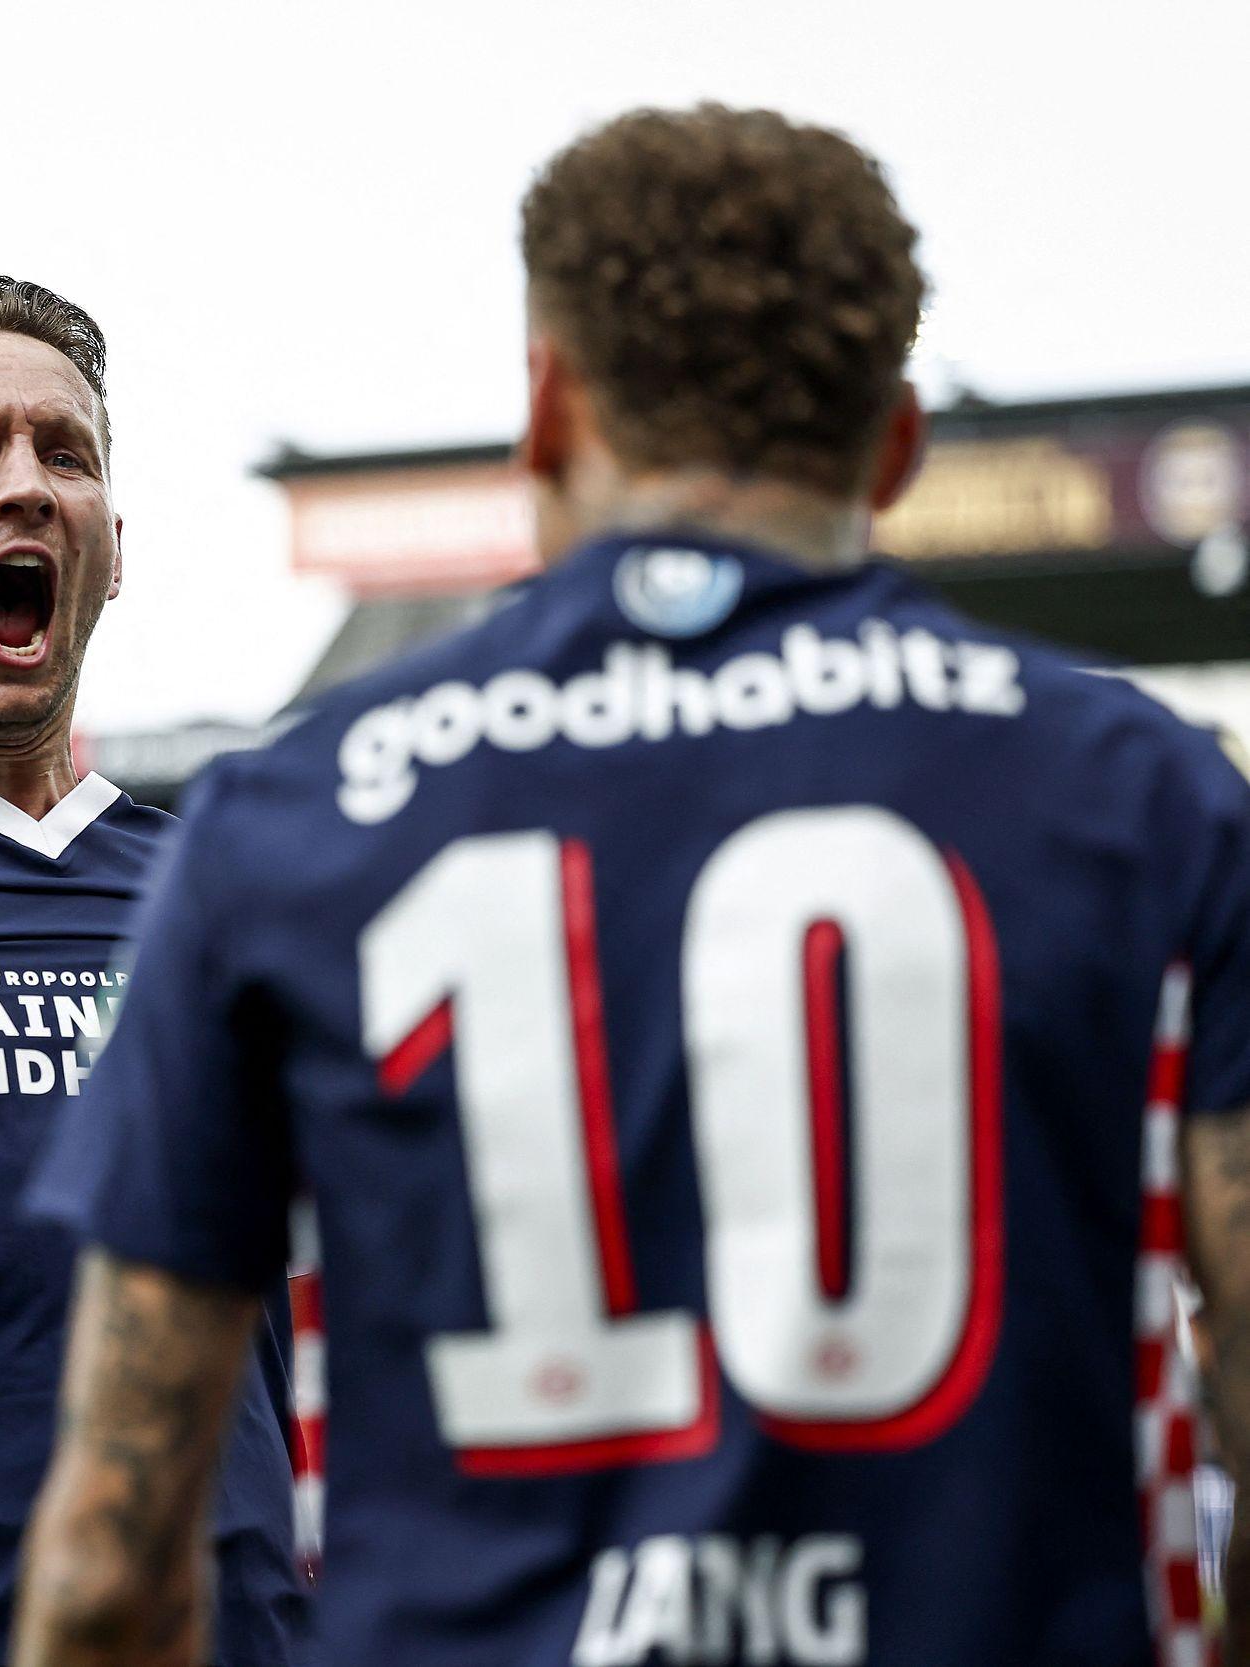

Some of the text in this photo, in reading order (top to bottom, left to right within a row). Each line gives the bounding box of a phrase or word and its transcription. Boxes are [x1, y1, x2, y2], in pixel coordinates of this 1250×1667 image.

[336, 617, 1026, 826] goodhabitz
[359, 804, 1002, 1474] 10
[570, 1532, 870, 1667] LANG
